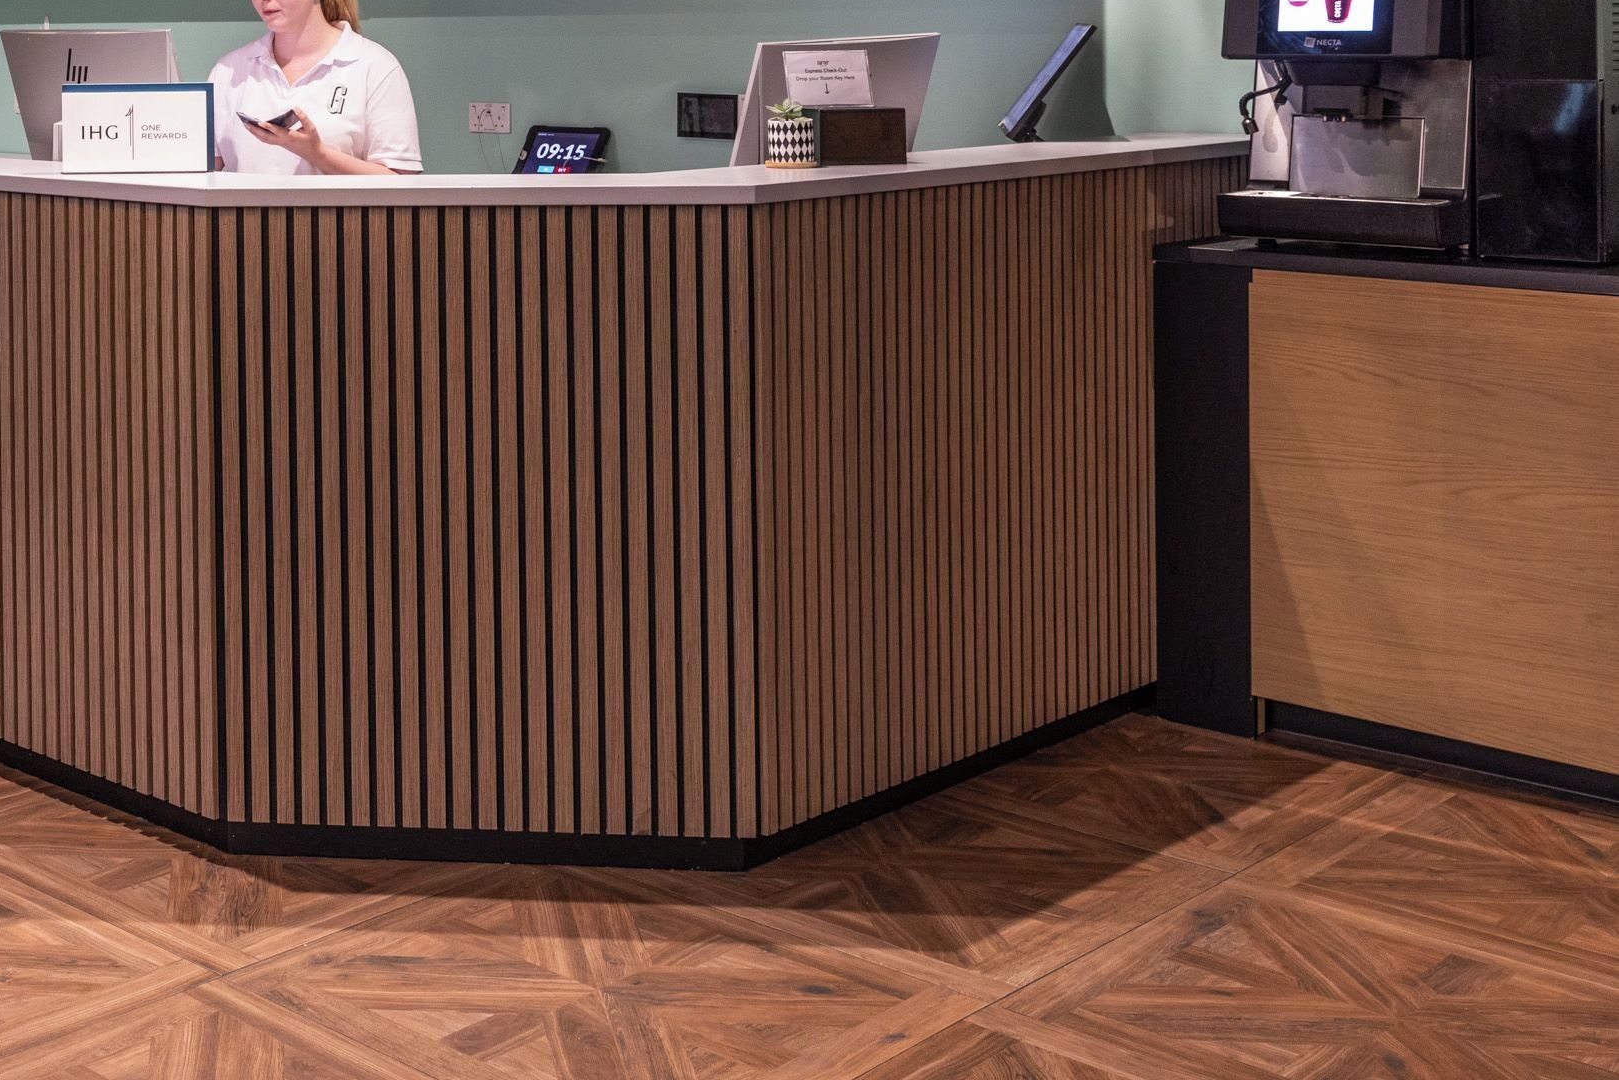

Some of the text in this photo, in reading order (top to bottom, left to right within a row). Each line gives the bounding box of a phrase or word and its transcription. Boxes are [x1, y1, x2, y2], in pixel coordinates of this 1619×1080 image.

[327, 84, 348, 115] G
[81, 124, 119, 140] IHG
[536, 143, 587, 160] 09:15
